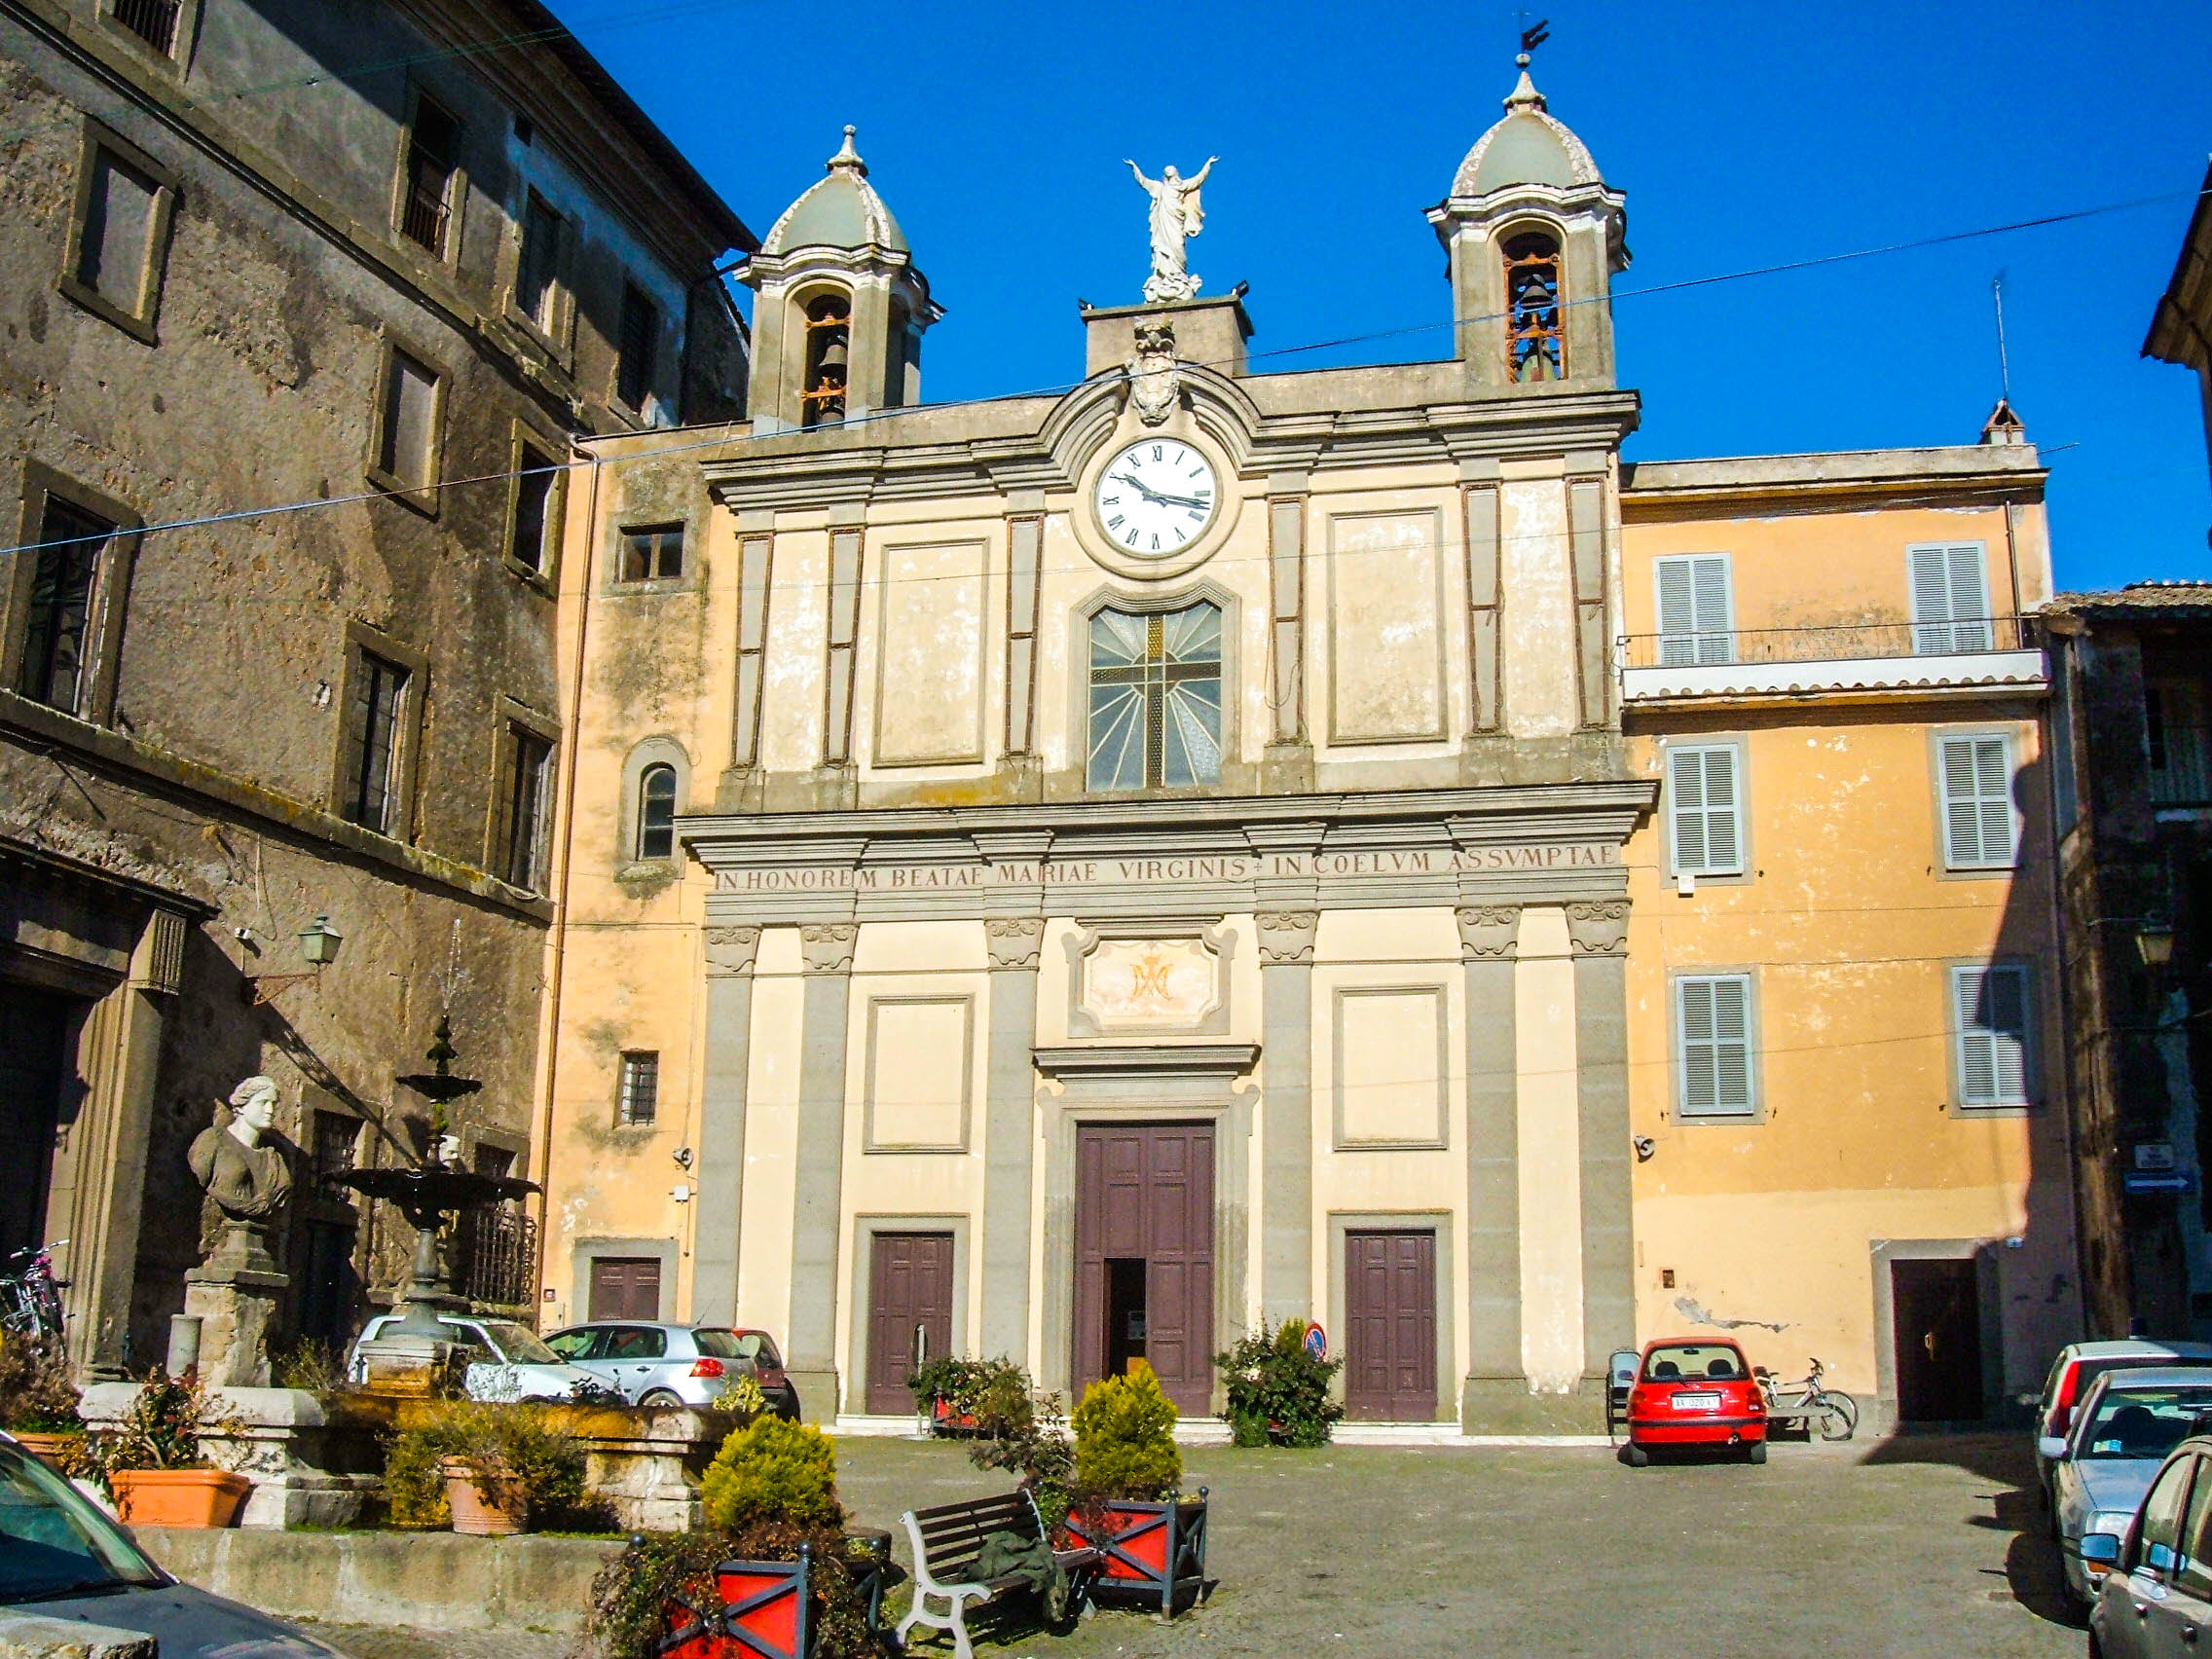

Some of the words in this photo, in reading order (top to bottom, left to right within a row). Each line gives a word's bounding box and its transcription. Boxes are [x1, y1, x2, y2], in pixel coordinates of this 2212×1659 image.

[716, 872, 738, 890] IN
[748, 869, 876, 890] HONOREM
[892, 866, 983, 887] BEATAE
[997, 863, 1098, 883] MARIAE
[1119, 858, 1246, 880] VIRGINIS
[1274, 856, 1302, 875] IN
[1313, 852, 1429, 874] COELVM
[1448, 845, 1615, 870] ASSVMPTAE
